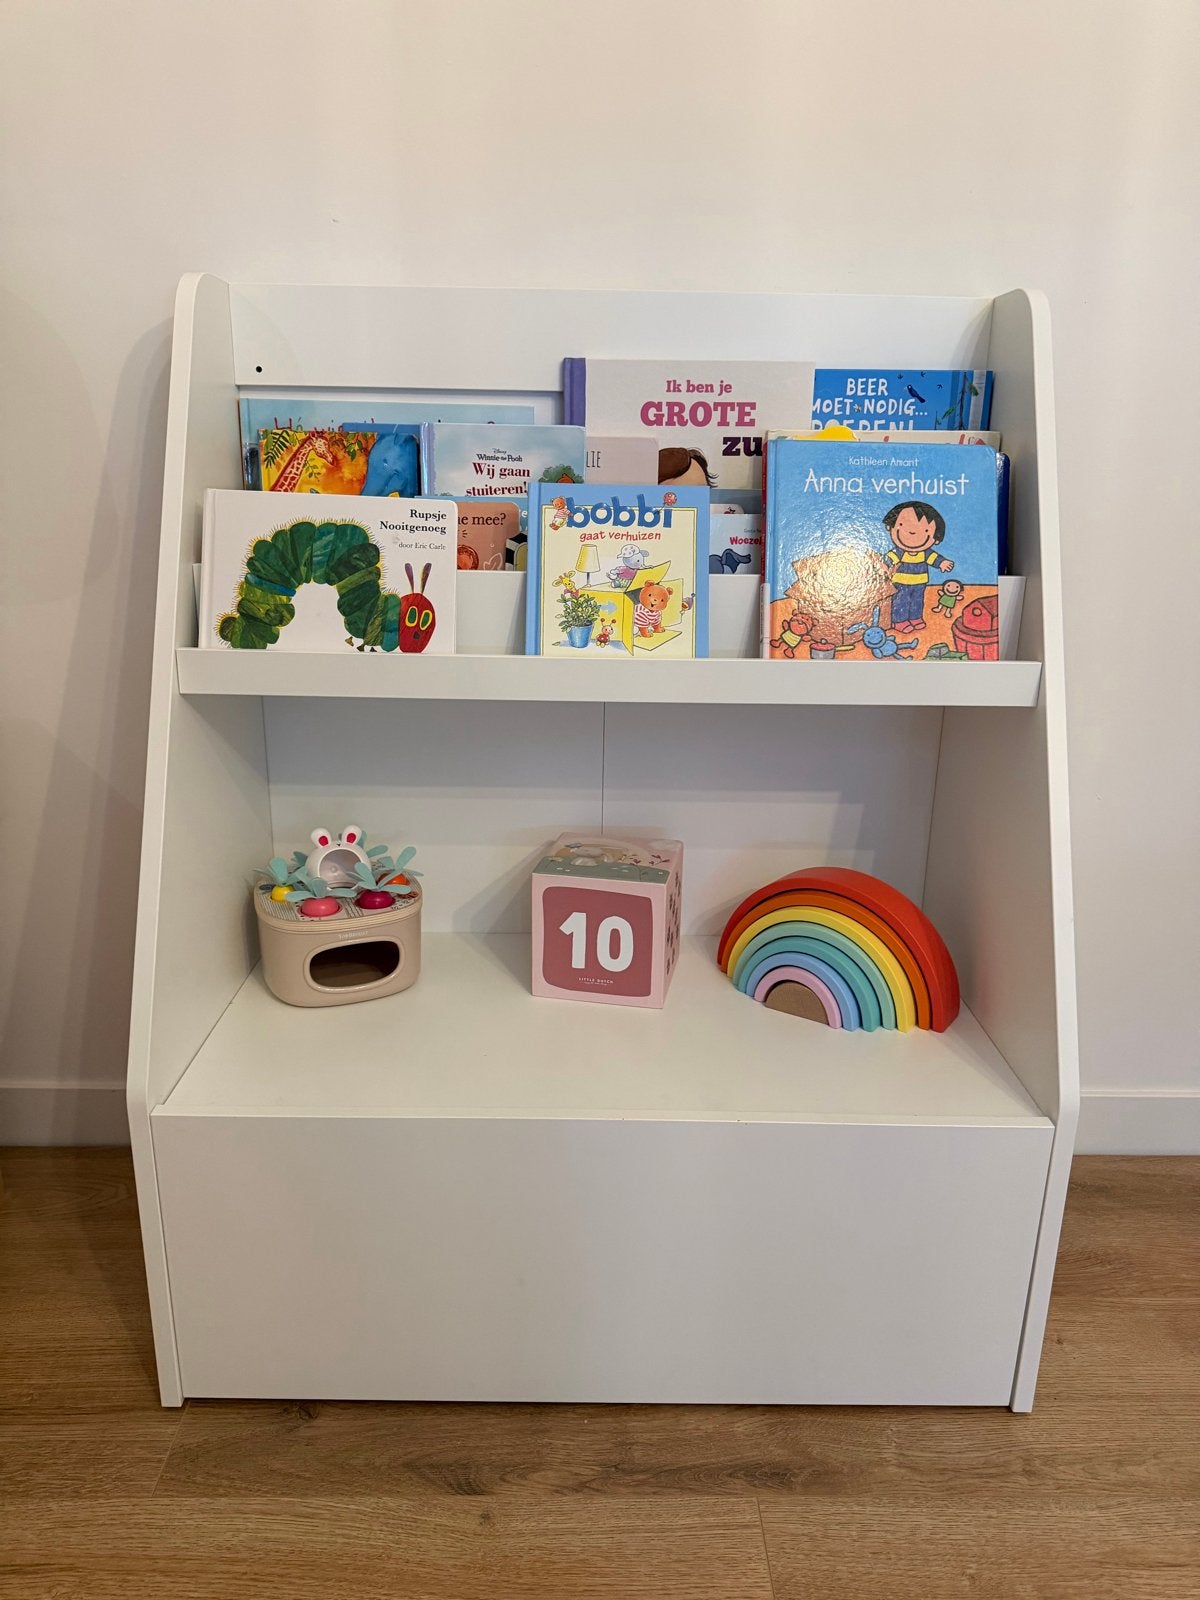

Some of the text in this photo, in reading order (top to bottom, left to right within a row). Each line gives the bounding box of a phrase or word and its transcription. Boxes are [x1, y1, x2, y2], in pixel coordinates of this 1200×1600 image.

[666, 380, 732, 396] Ik ben je
[846, 377, 889, 396] BEER
[640, 401, 757, 427] GROTE
[864, 398, 928, 416] NODIG...
[848, 455, 919, 467] Kathleen Amant
[472, 462, 531, 479] Wij gaan
[465, 481, 528, 497] stuiteren!
[803, 468, 969, 495] Anna verhuist
[410, 509, 447, 521] Rupsje
[566, 494, 672, 528] bobbi
[471, 513, 506, 526] mee?
[380, 521, 447, 535] Nooitgenoeg
[579, 530, 661, 542] gaat verhuizen
[414, 542, 427, 550] Eric
[428, 543, 446, 551] Carle
[559, 911, 634, 972] 10
